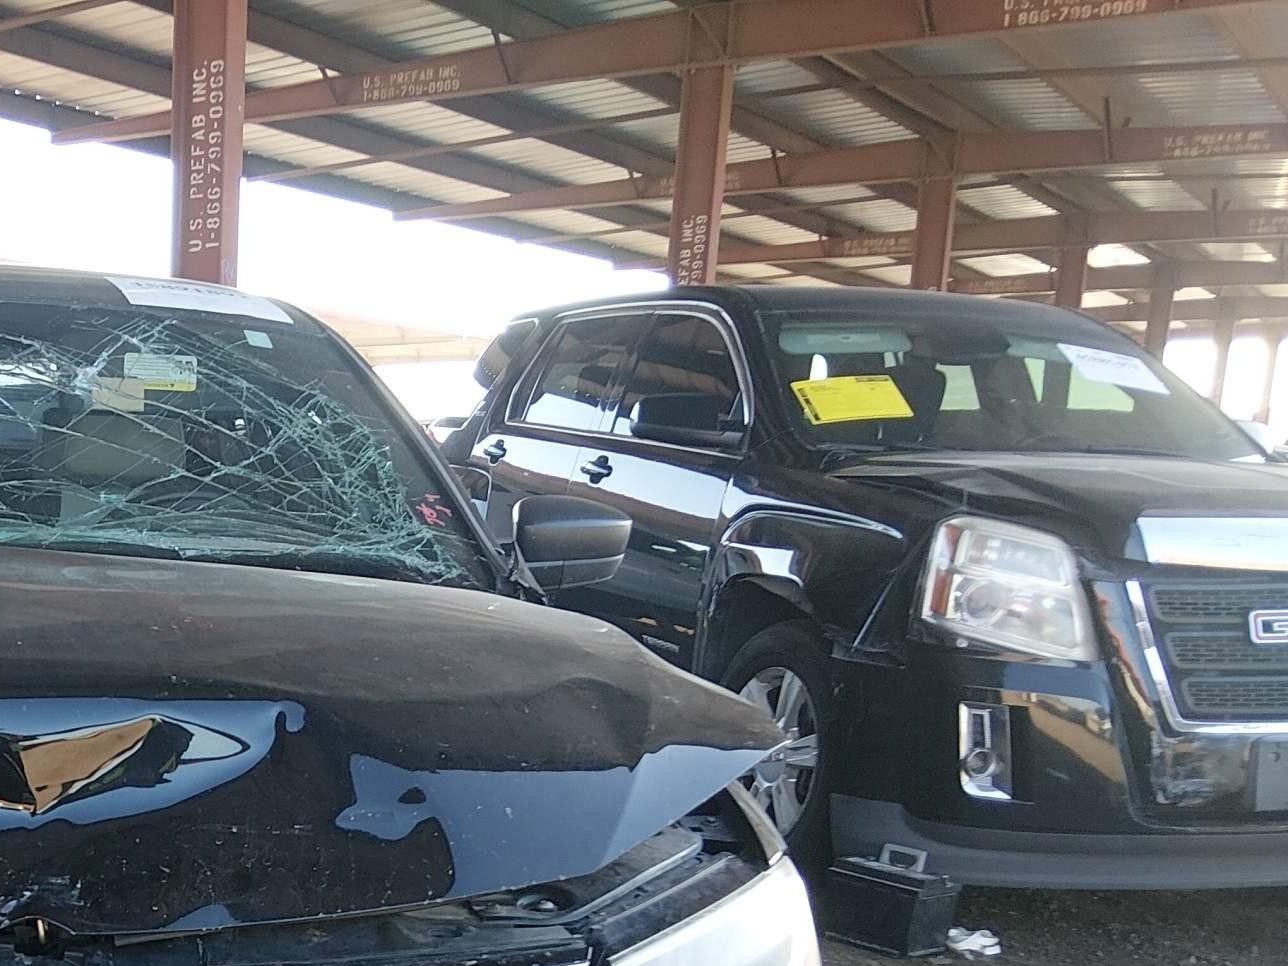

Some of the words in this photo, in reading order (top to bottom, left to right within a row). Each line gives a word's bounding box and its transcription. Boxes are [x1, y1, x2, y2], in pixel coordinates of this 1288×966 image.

[192, 60, 208, 103] INC.
[189, 113, 206, 199] PREFAB
[205, 59, 225, 249] 1-866-799-0969
[188, 211, 204, 253] U.S.
